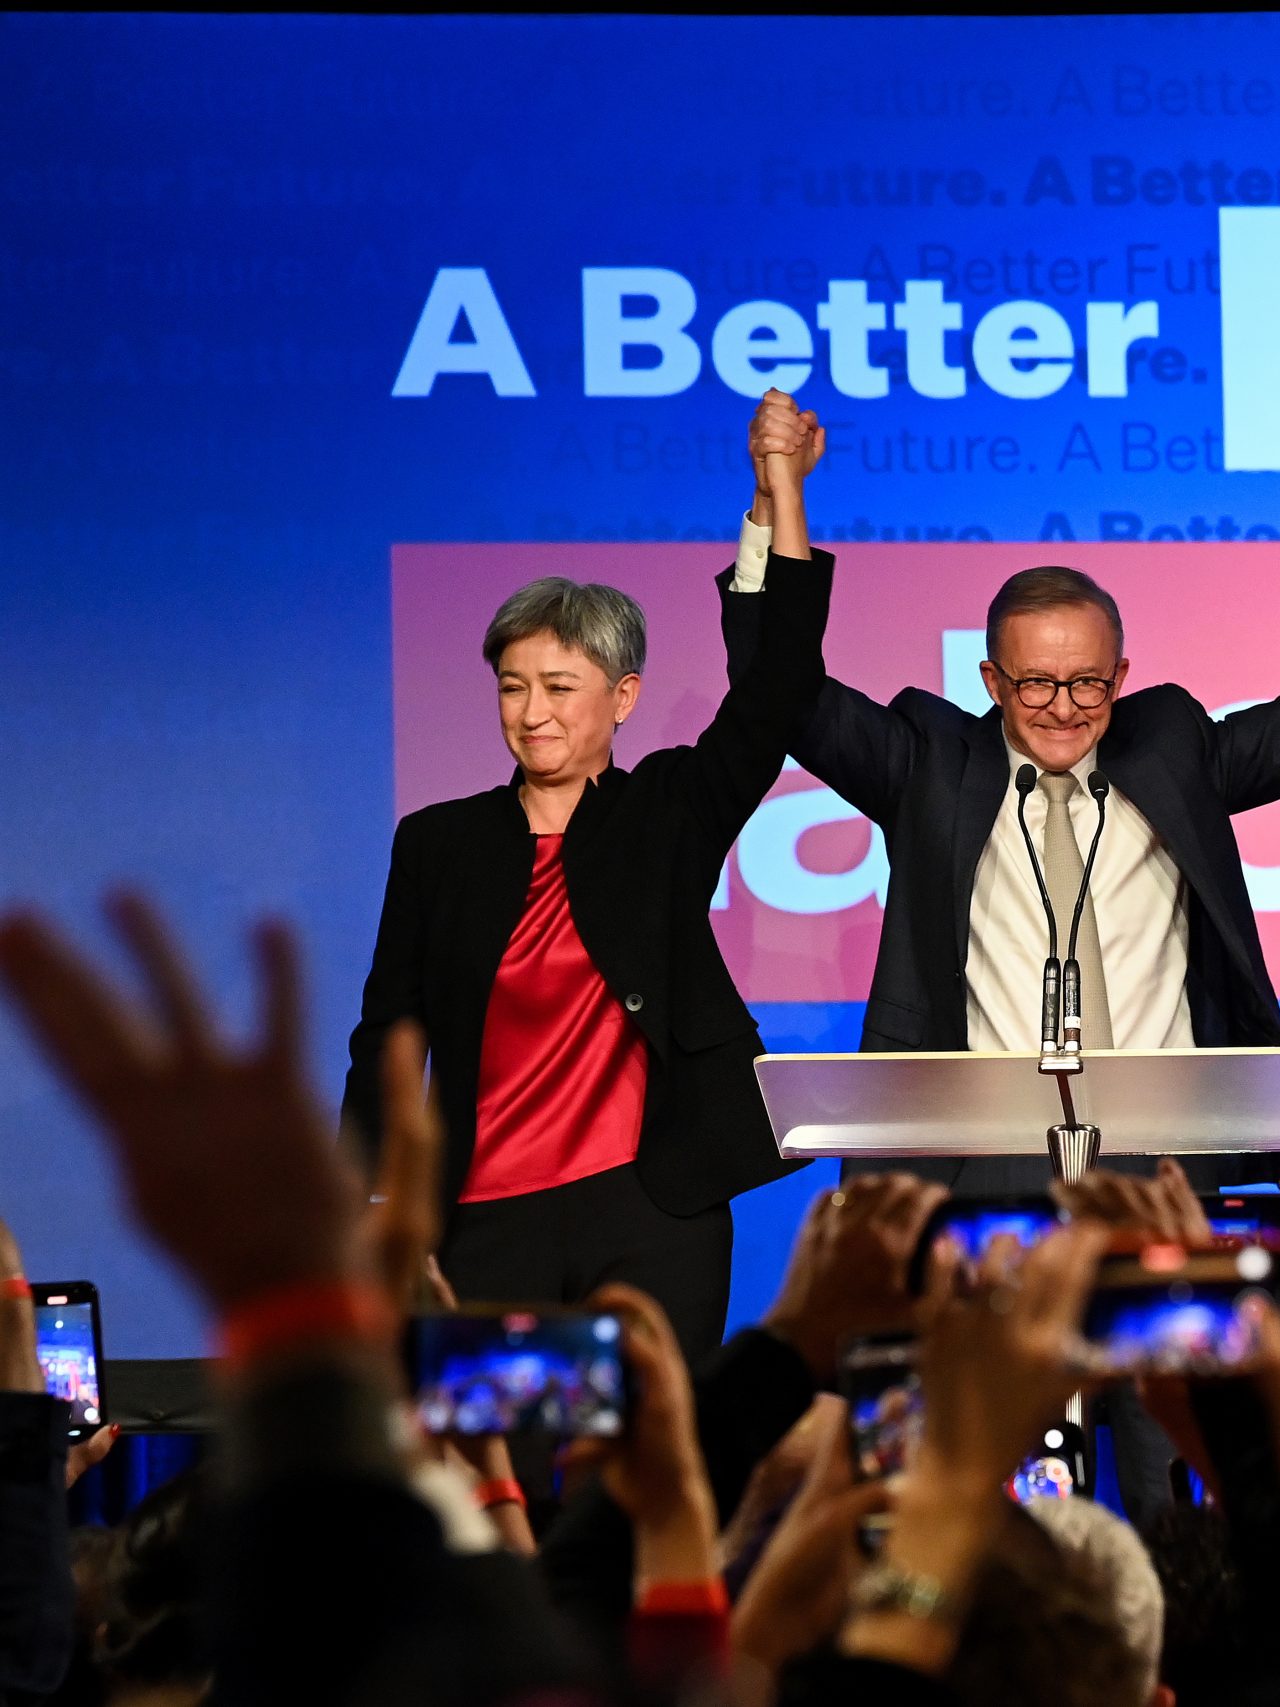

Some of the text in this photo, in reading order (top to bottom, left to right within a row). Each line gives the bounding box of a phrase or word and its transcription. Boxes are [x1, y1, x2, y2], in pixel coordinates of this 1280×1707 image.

[1050, 64, 1096, 116] A
[758, 156, 1007, 206] Future.
[1023, 154, 1077, 206] A
[861, 243, 901, 295] A
[917, 243, 1110, 296] Better
[391, 264, 541, 399] A
[579, 264, 1162, 401] Better
[550, 421, 596, 476] A
[612, 420, 753, 476] Bett
[822, 420, 1038, 475] Future.
[1057, 419, 1104, 474] A
[1121, 419, 1221, 475] Bet
